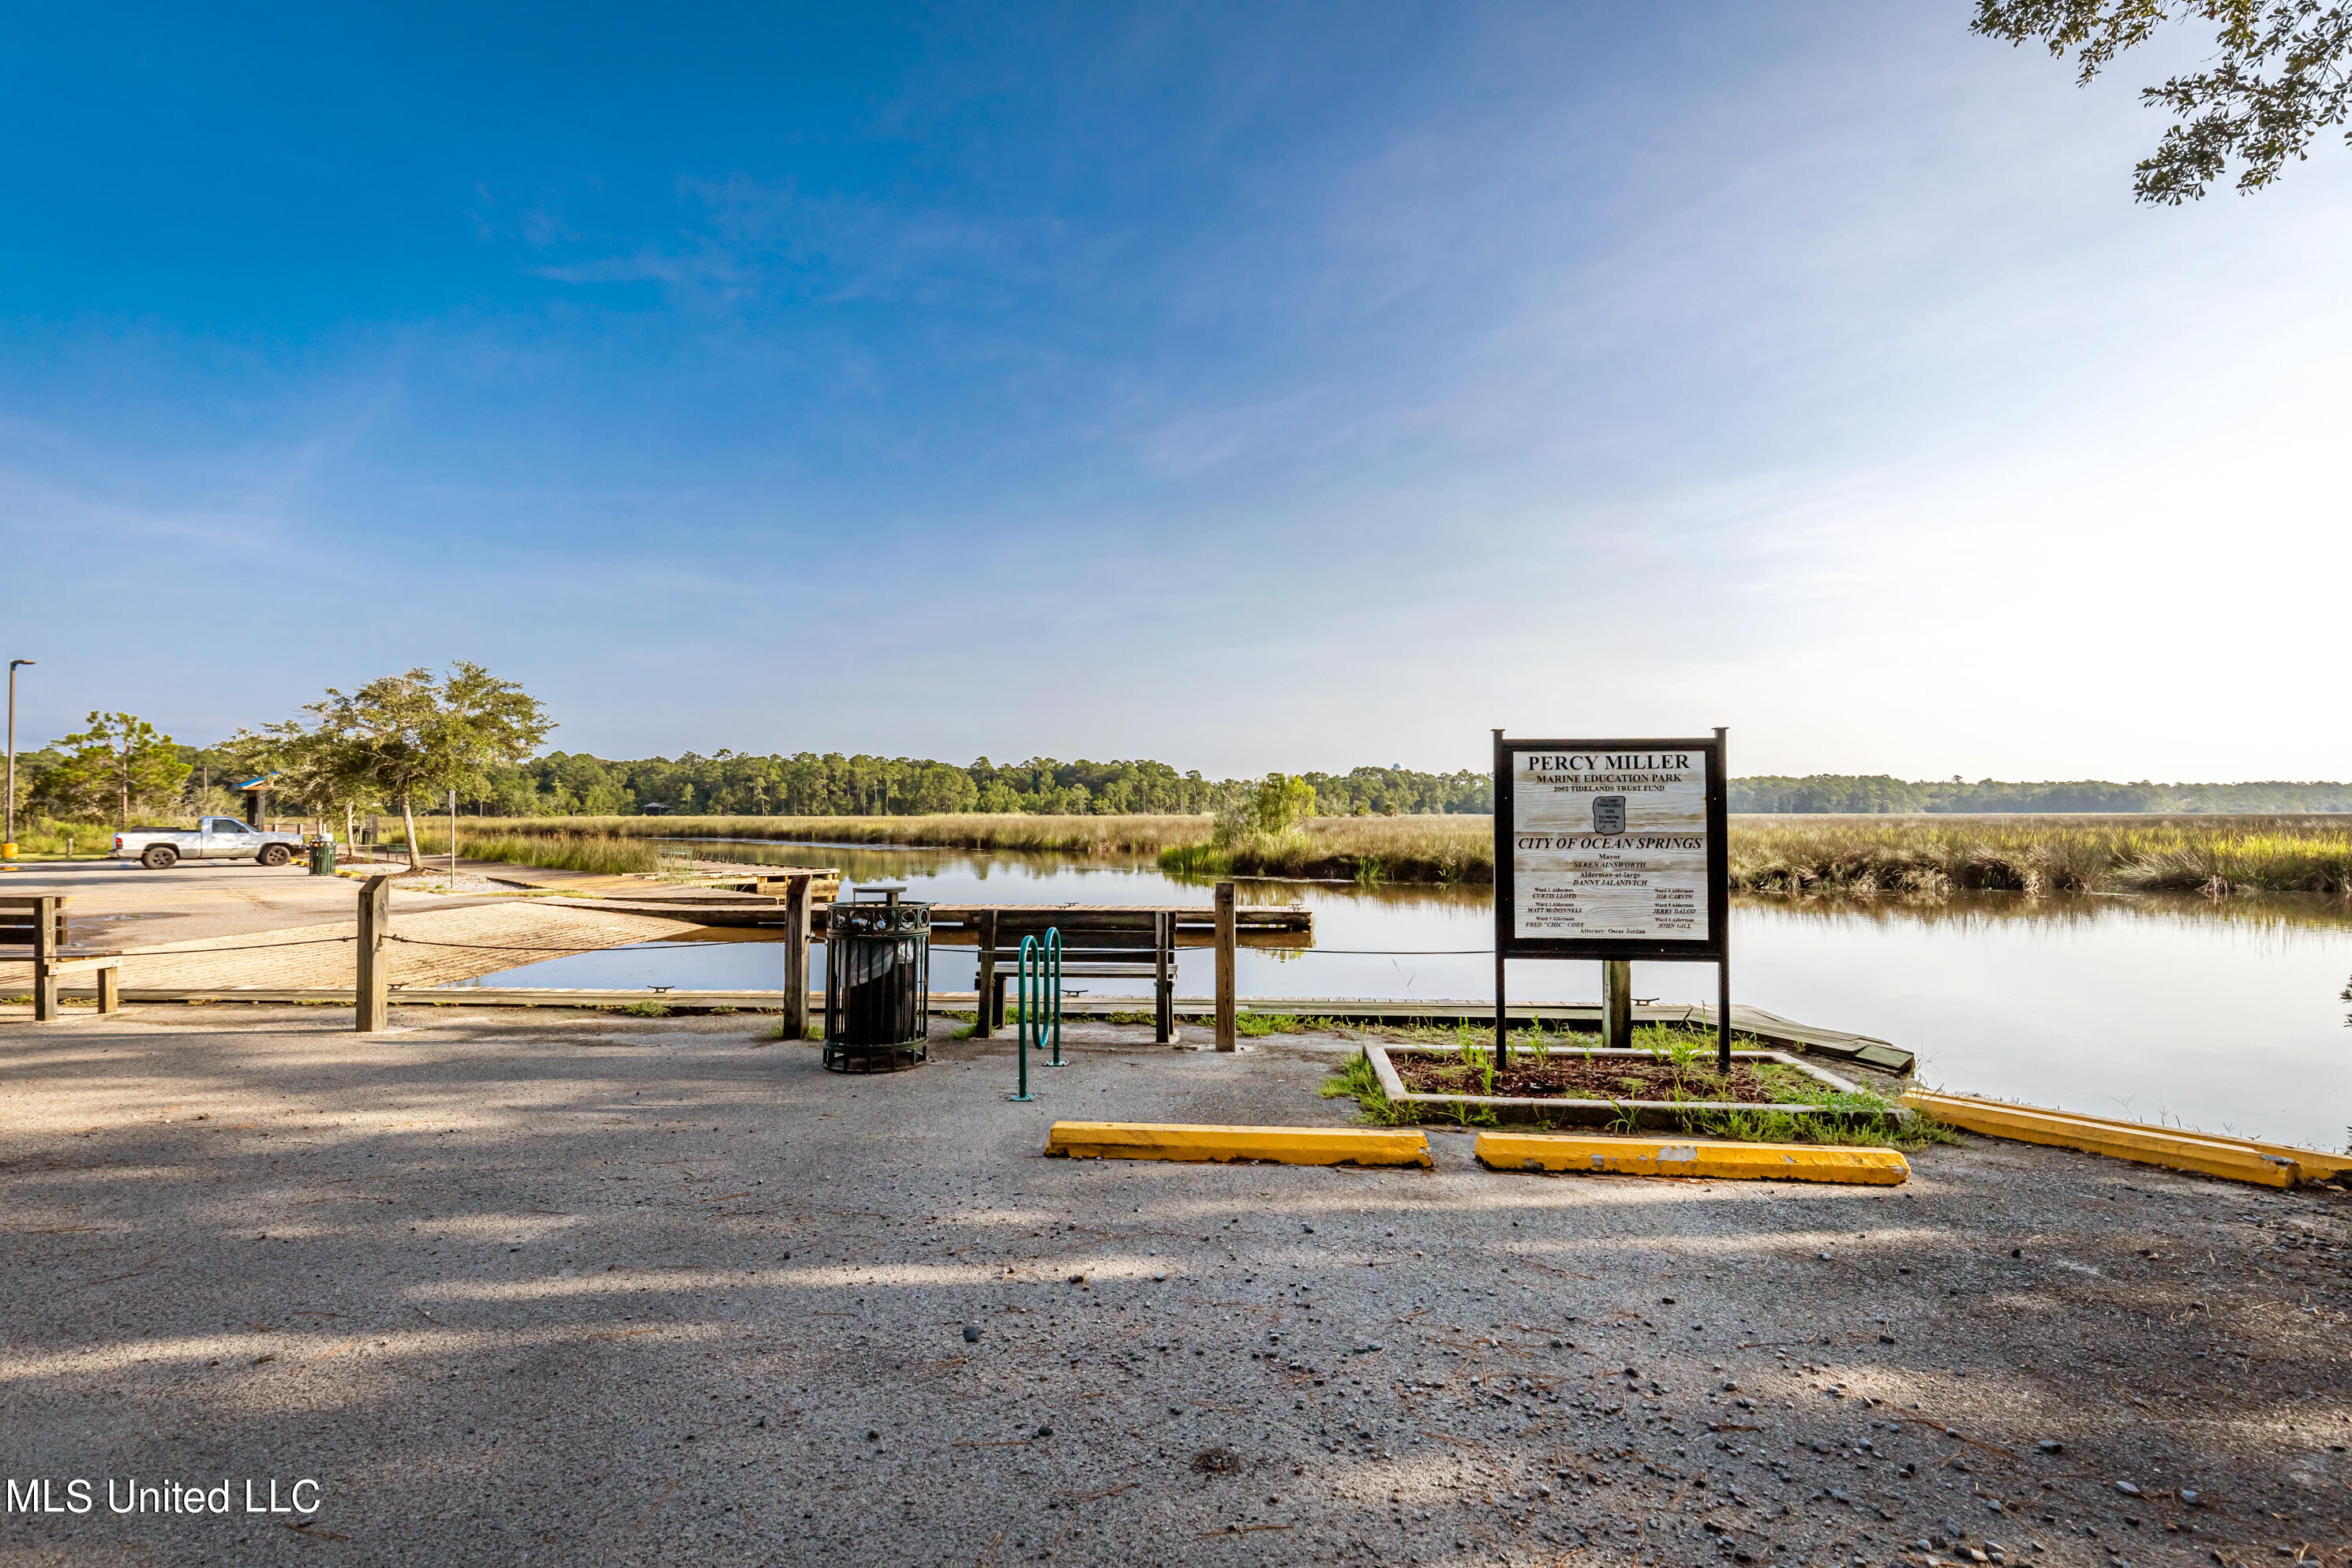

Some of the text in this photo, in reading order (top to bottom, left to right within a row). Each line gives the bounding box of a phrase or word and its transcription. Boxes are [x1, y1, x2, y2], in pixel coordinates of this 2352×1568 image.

[1528, 754, 1690, 771] PERCY MILLER
[1537, 773, 1682, 784] MARINE EDUCATION PARK
[1518, 837, 1702, 849] CITY OF OCEAN SPRINGS
